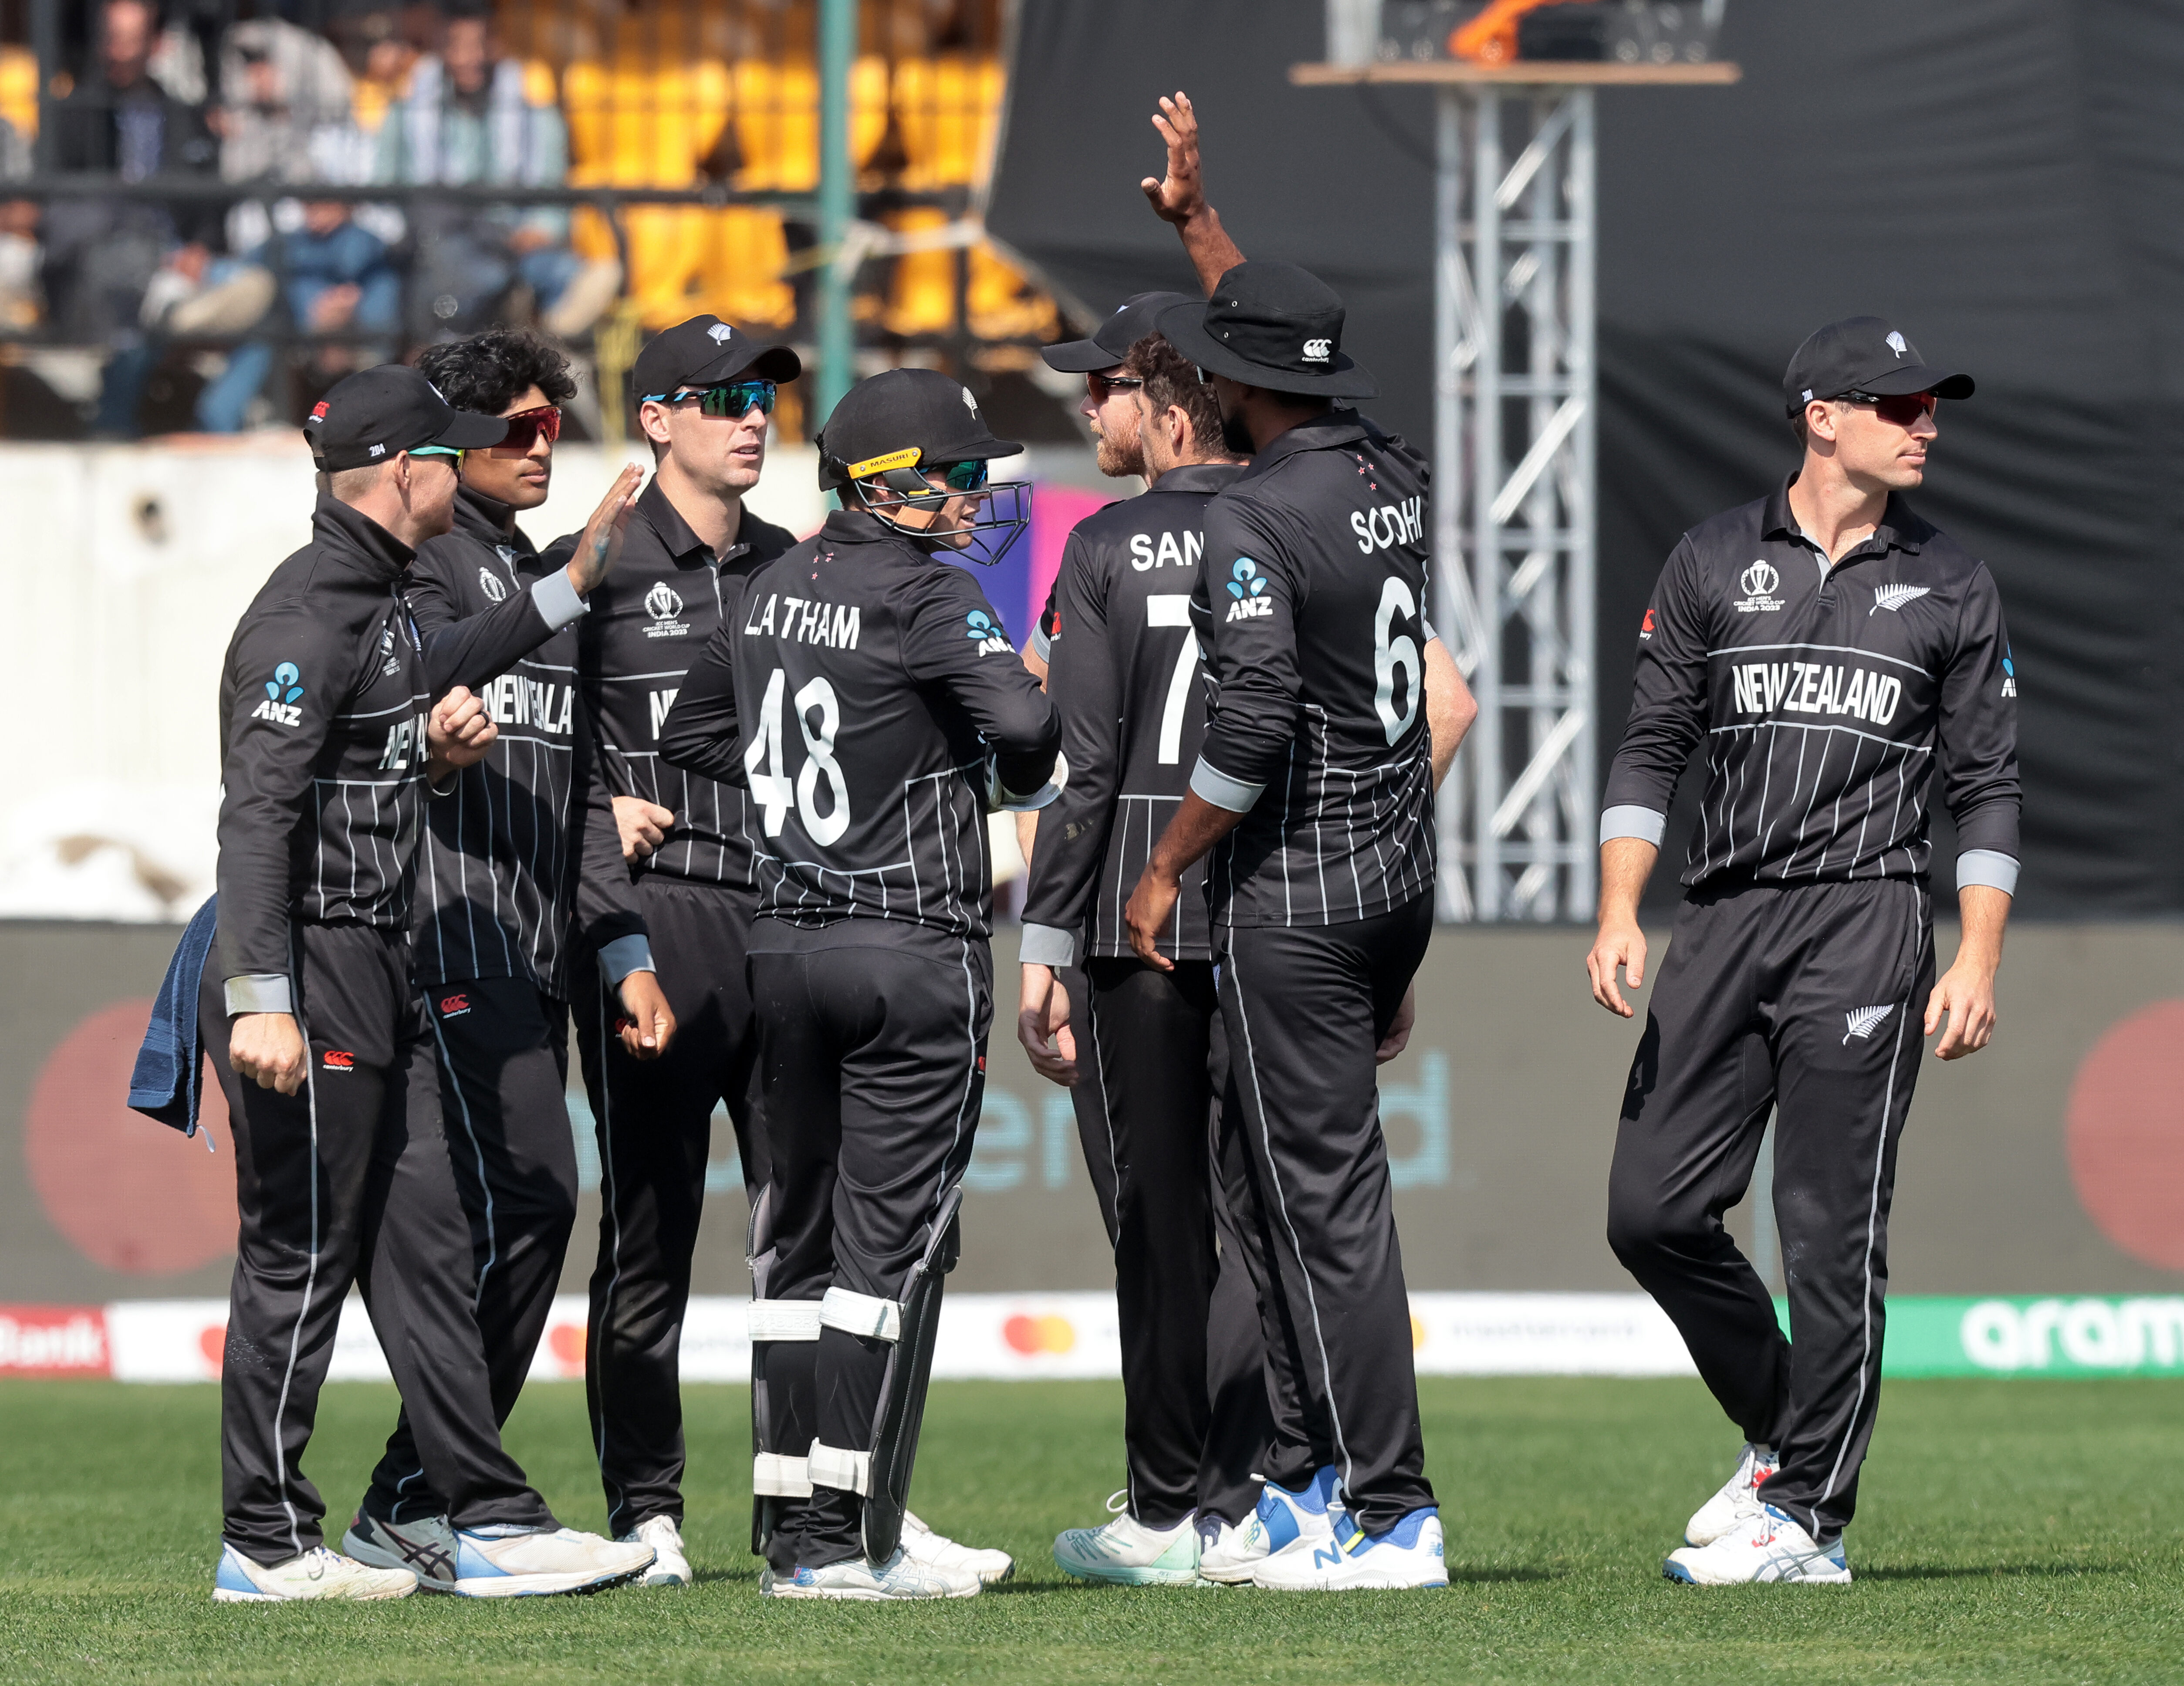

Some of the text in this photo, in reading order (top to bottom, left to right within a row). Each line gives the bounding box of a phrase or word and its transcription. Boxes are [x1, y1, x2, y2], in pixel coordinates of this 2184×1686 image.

[1802, 389, 1813, 402] 200
[369, 443, 385, 457] 204
[870, 453, 908, 467] MASURI
[1351, 495, 1423, 554] SODHI
[744, 593, 860, 650] LATHAM
[1226, 596, 1273, 622] ANZ
[979, 636, 1016, 658] AN
[1374, 576, 1420, 747] 6
[482, 674, 529, 725] NEW
[1732, 662, 1901, 726] NEW ZEALAND
[251, 700, 302, 727] ANZ
[744, 668, 850, 847] 48
[443, 1007, 471, 1019] canterbury
